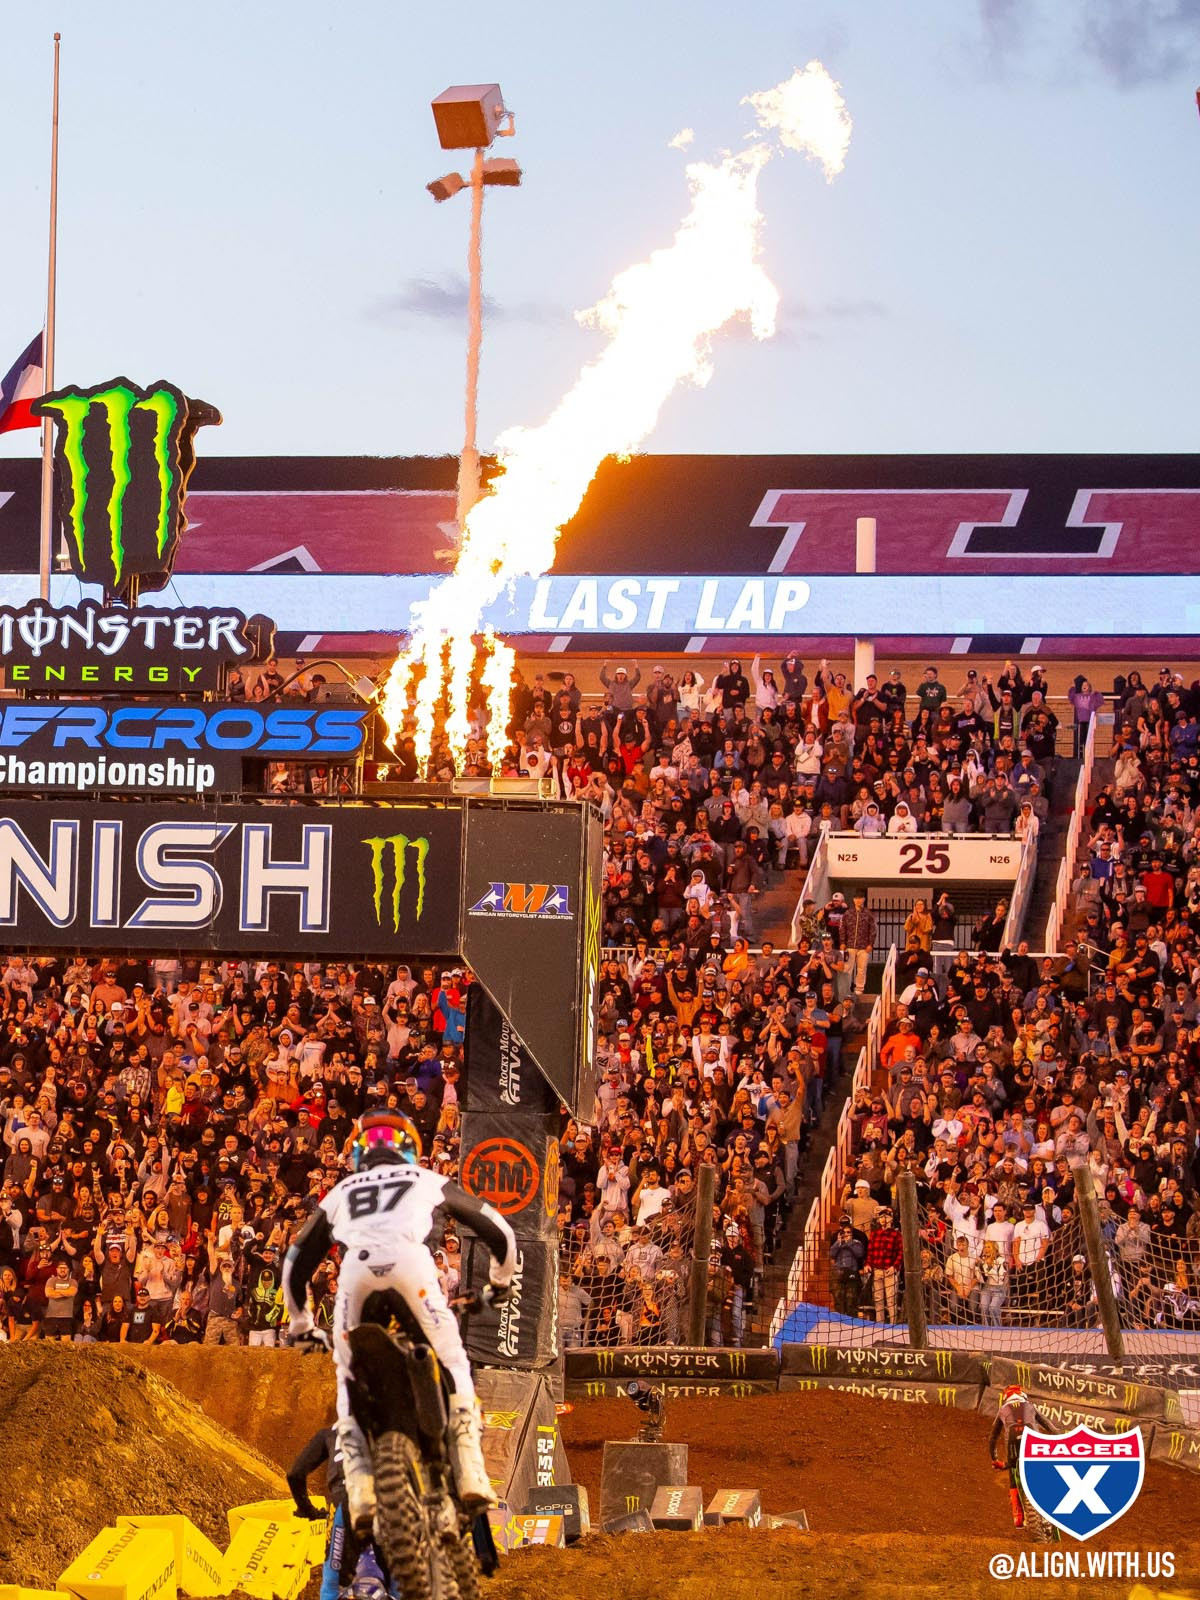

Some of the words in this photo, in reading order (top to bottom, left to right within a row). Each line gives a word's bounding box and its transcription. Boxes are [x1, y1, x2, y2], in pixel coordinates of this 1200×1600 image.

[528, 579, 681, 630] LAST
[694, 579, 811, 630] LAP
[12, 665, 203, 682] ENERGY
[837, 853, 858, 862] N25
[899, 843, 951, 874] 25
[989, 855, 1011, 864] N26
[467, 882, 575, 915] AMA
[499, 1054, 509, 1088] ROCKY
[477, 1161, 525, 1193] RM
[348, 1180, 414, 1220] 87
[624, 1352, 721, 1368] MONSTER
[836, 1348, 929, 1367] MONSTER
[850, 1366, 915, 1376] ENERGY
[616, 1382, 721, 1398] MNSTER
[1038, 1371, 1118, 1399] MONSTER
[535, 1503, 573, 1512] GoPro
[95, 1527, 139, 1571] DUNLOP
[246, 1522, 280, 1572] DUNLOP
[333, 1526, 345, 1561] YAMAHA
[193, 1550, 222, 1586] DUNLOP
